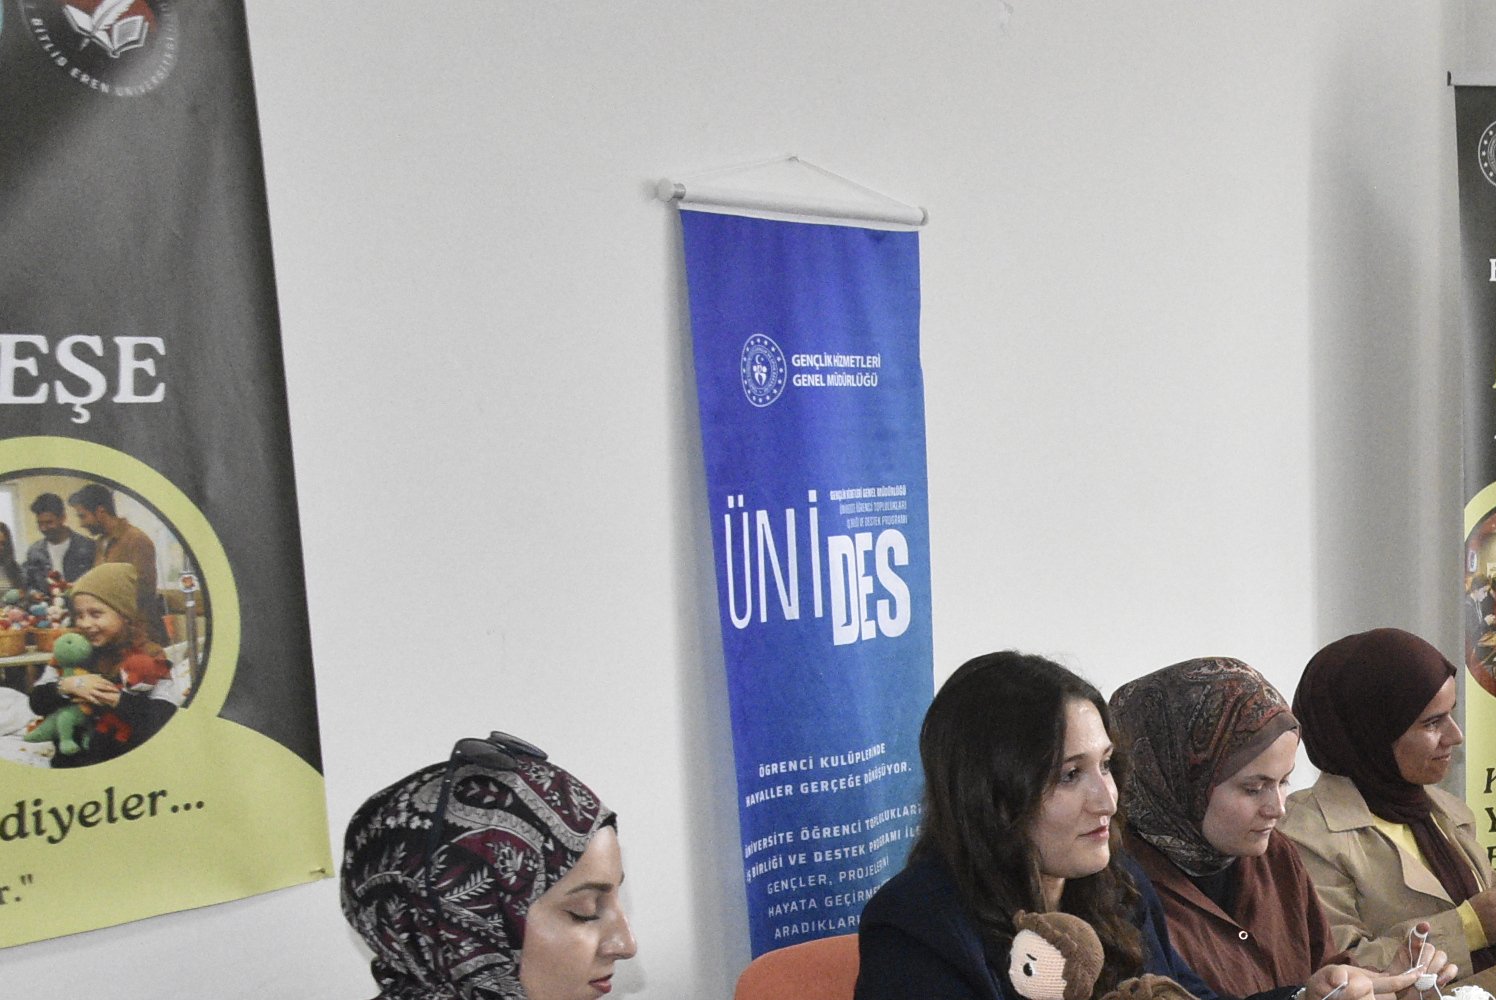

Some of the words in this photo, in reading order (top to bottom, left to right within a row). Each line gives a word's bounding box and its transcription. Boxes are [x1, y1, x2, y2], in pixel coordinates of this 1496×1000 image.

[791, 352, 833, 370] GENÇLİK
[833, 353, 881, 369] HİZMETLERİ
[0, 333, 167, 424] EŞE
[793, 374, 826, 387] GENEL
[826, 371, 878, 388] MÜDÜRLÜĞÜ
[745, 784, 793, 808] HAYALLER
[800, 774, 862, 794] GERÇEĞE
[0, 786, 205, 844] diyeler...
[800, 820, 862, 841] ÖĞRENCİ
[788, 853, 807, 866] VE
[813, 844, 866, 863] DESTEK
[868, 828, 901, 854] PROGRAMI
[767, 874, 833, 895] GENÇLER,
[768, 898, 817, 918] HAYATA
